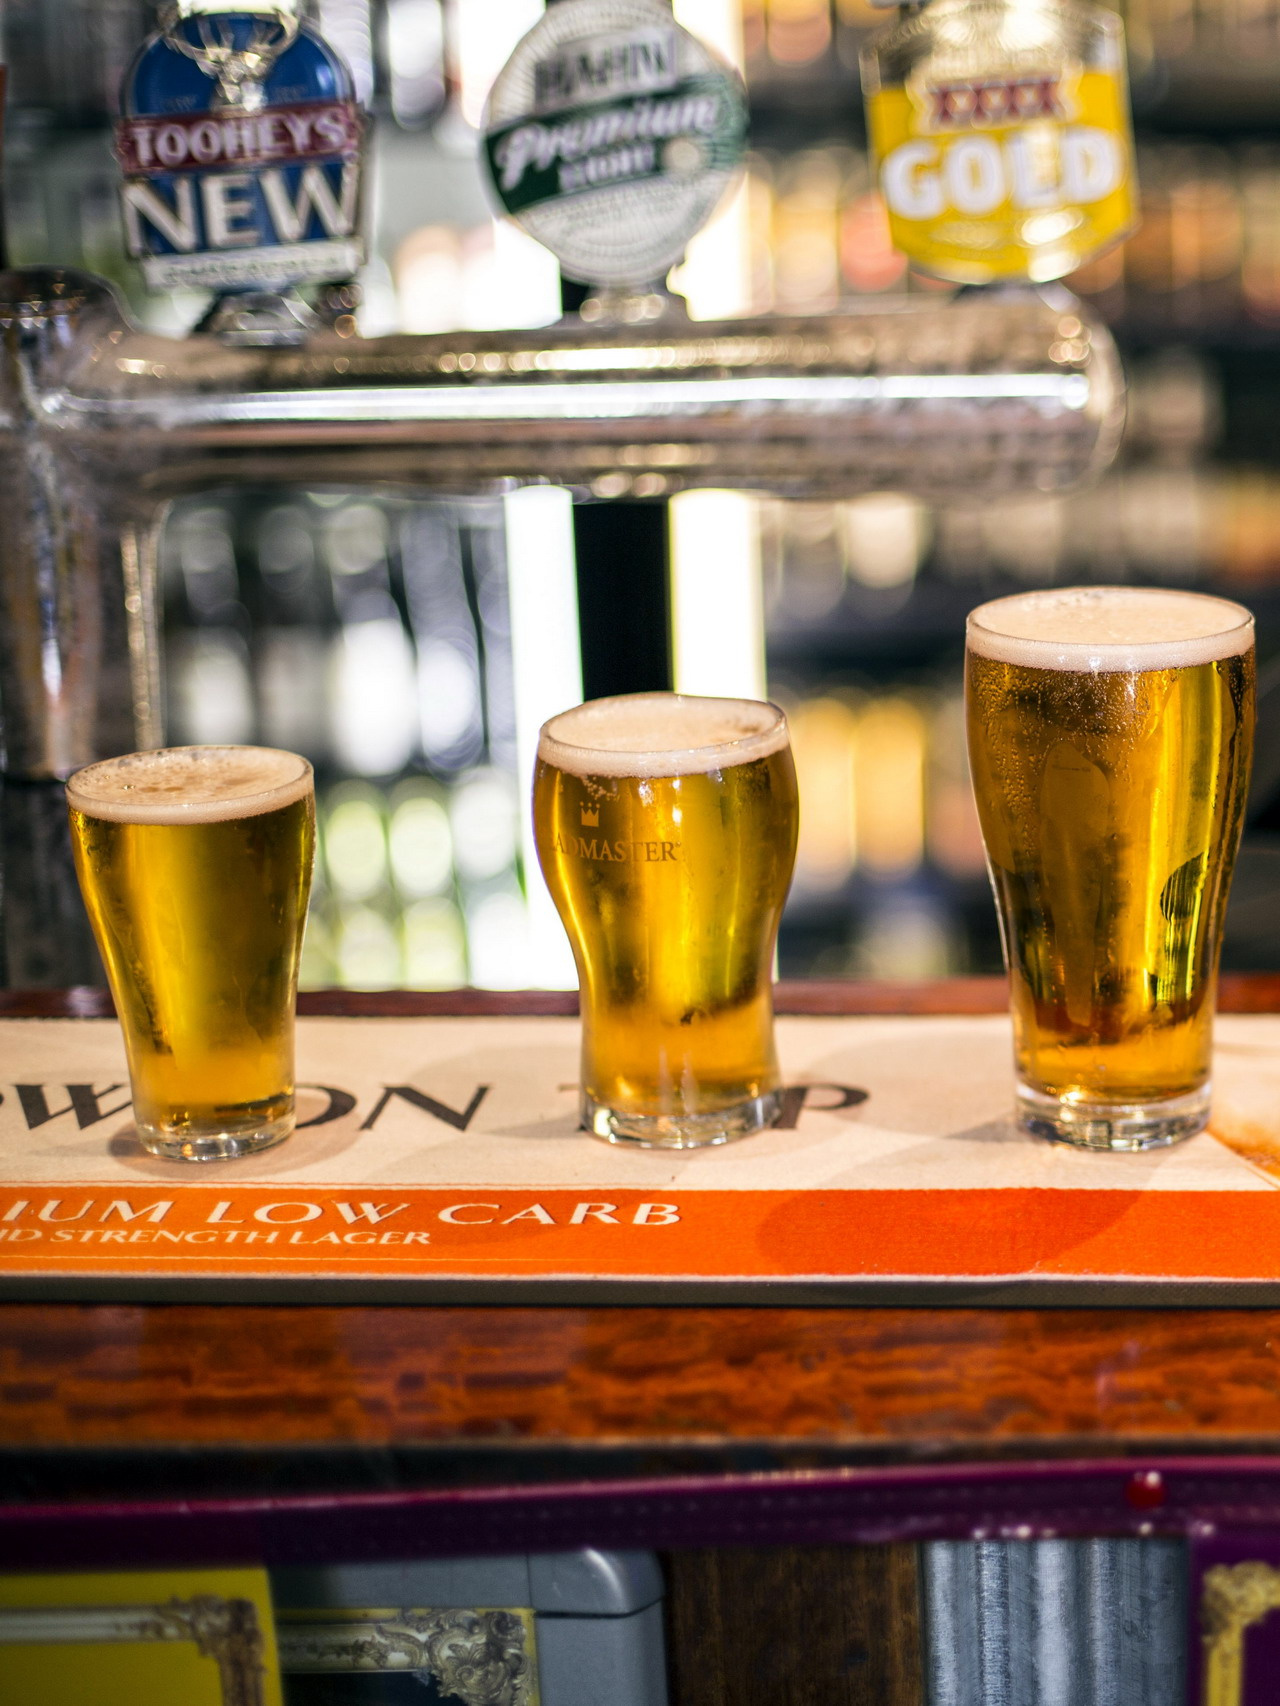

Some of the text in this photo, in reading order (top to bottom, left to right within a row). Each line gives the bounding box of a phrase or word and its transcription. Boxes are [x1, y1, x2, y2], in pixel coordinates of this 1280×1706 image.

[130, 108, 347, 167] TOOHEYS
[882, 127, 1123, 220] GOLD
[121, 164, 358, 258] NEW
[50, 1229, 281, 1245] STRENGTH
[288, 1230, 432, 1246] LAGER
[206, 1201, 410, 1225] LOW
[437, 1203, 682, 1226] CARB
